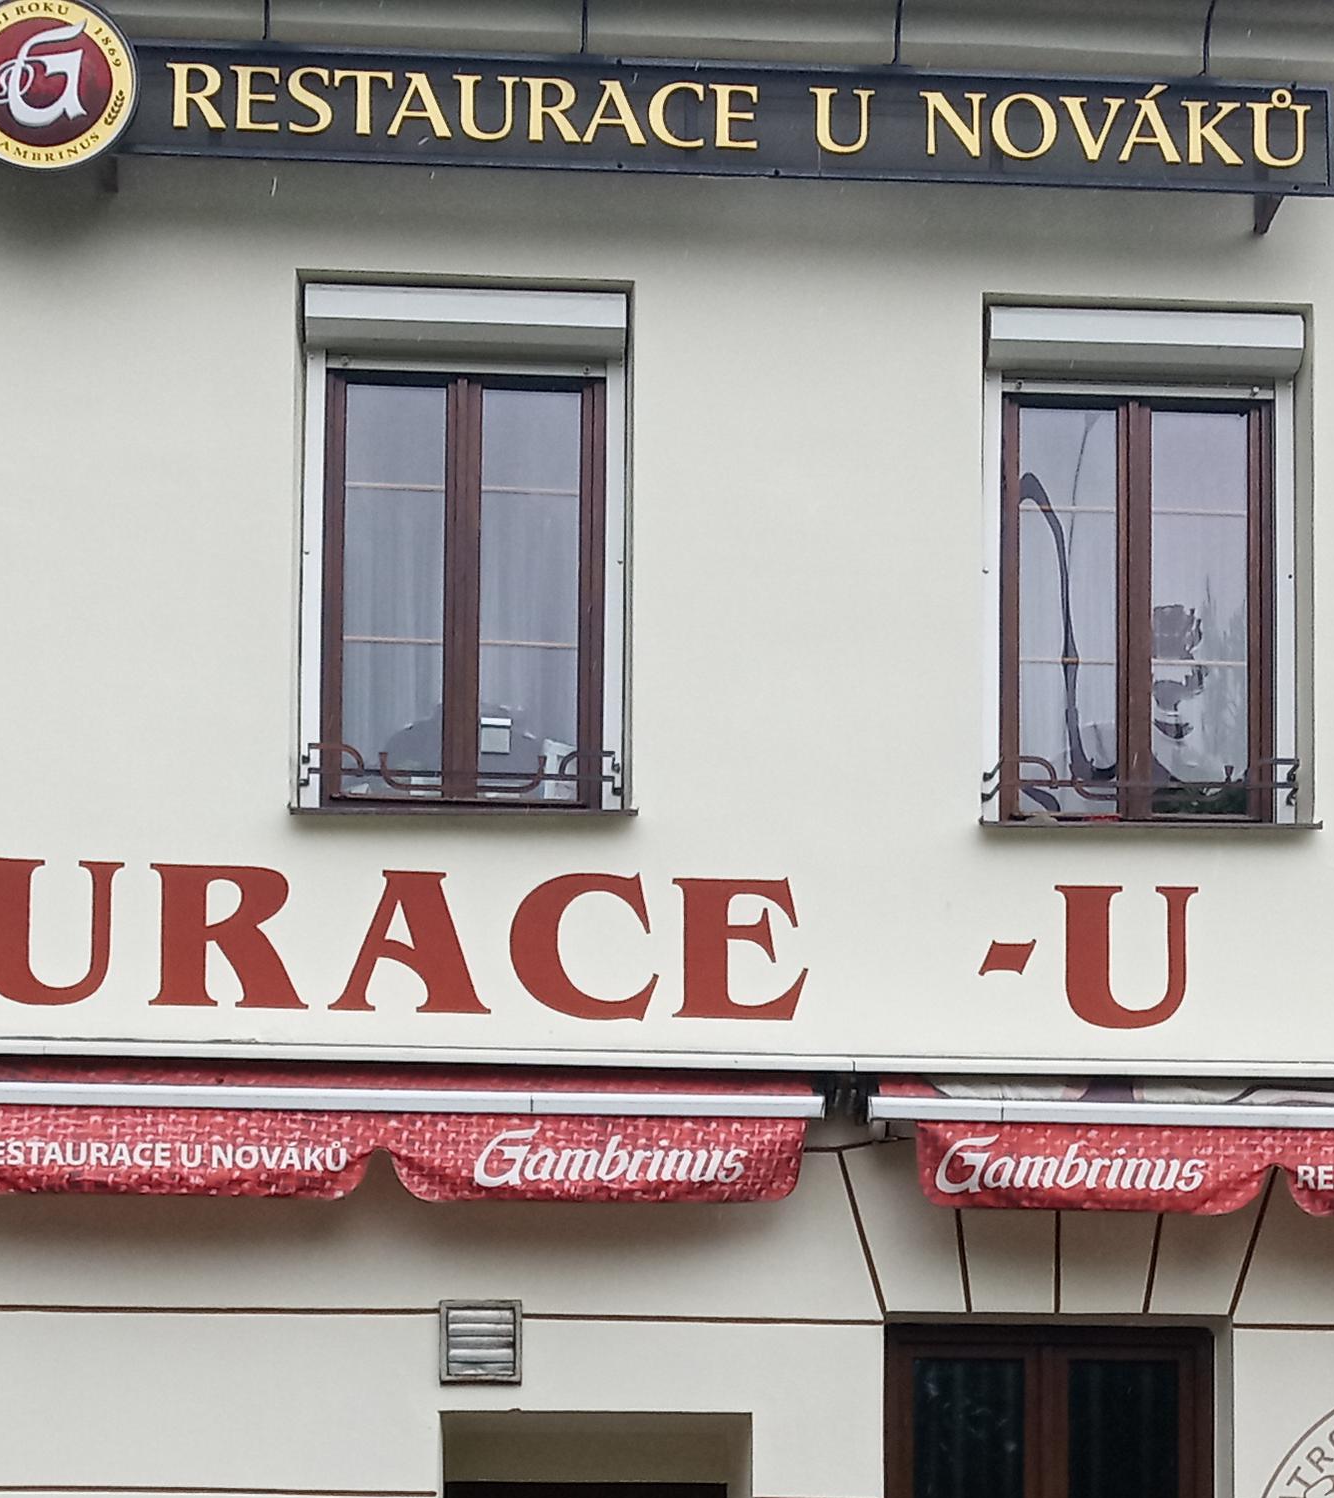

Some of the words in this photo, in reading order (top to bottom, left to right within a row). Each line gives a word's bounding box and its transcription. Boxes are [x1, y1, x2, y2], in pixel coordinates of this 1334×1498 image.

[15, 2, 70, 16] ROKU
[93, 26, 122, 69] 1869
[165, 61, 759, 150] RESTAURACE
[808, 85, 876, 156] U
[918, 84, 1312, 168] NOVÁKŮ
[179, 1143, 203, 1169] U
[211, 1140, 349, 1173] NOVÁKŮ
[473, 1125, 749, 1188] Gambrinus
[934, 1133, 1209, 1194] Gambrinus
